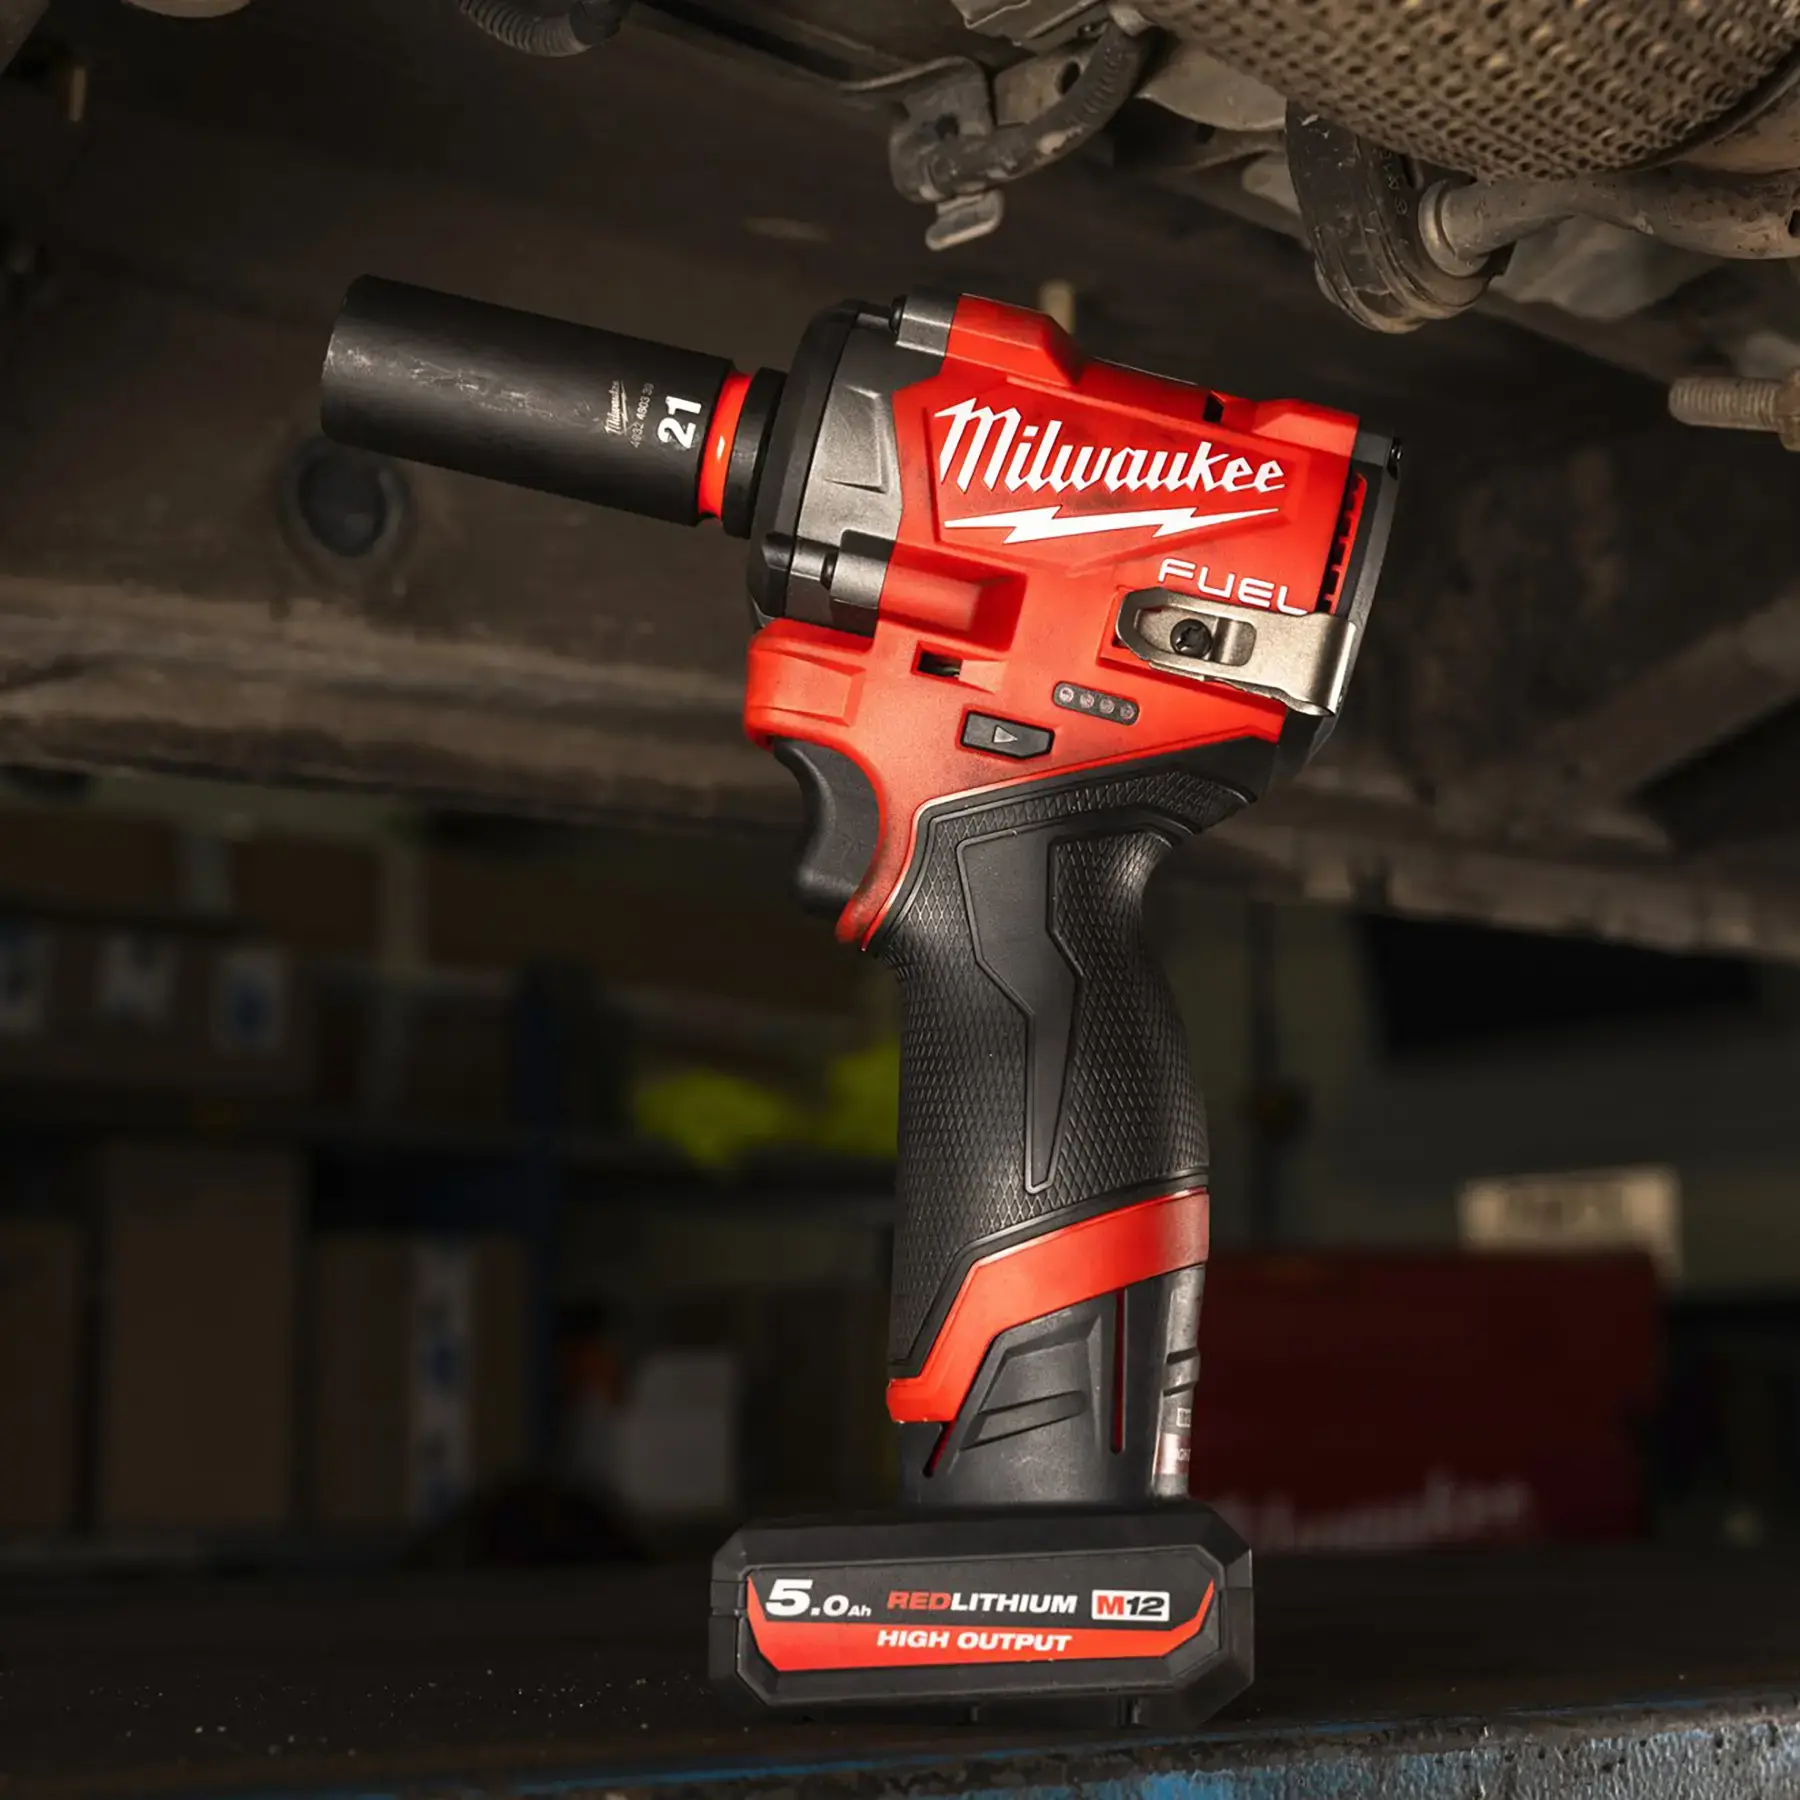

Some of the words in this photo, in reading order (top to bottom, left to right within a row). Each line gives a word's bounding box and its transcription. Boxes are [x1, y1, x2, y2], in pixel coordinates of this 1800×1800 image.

[657, 395, 702, 449] 21
[934, 397, 1286, 495] Milwaukee
[1158, 558, 1309, 616] FUEL
[886, 1590, 1078, 1614] REDLITHIUM
[1096, 1595, 1166, 1617] M12
[877, 1630, 949, 1649] HIGH
[956, 1632, 1073, 1652] OUTPUT
